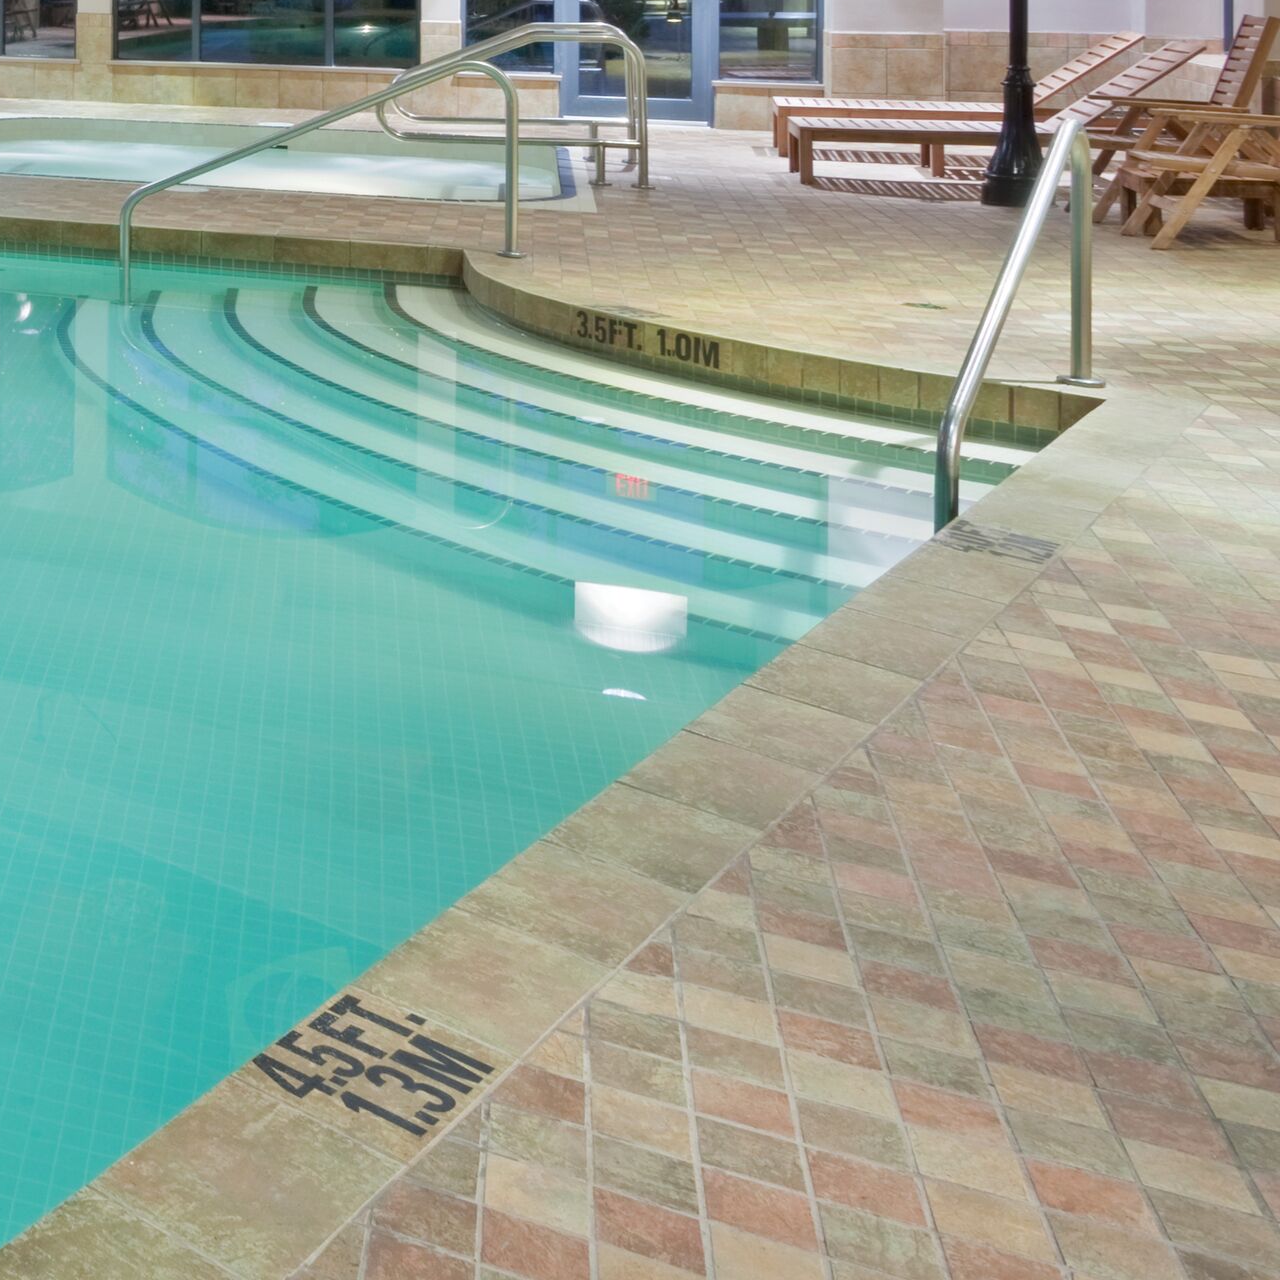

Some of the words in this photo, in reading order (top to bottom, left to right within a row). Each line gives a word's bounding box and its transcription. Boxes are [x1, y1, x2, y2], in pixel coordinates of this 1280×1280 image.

[577, 310, 642, 351] 3.5FT.
[657, 328, 720, 369] 1.0M
[252, 994, 428, 1099] 4.5FT.
[340, 1033, 495, 1137] 1.3M
